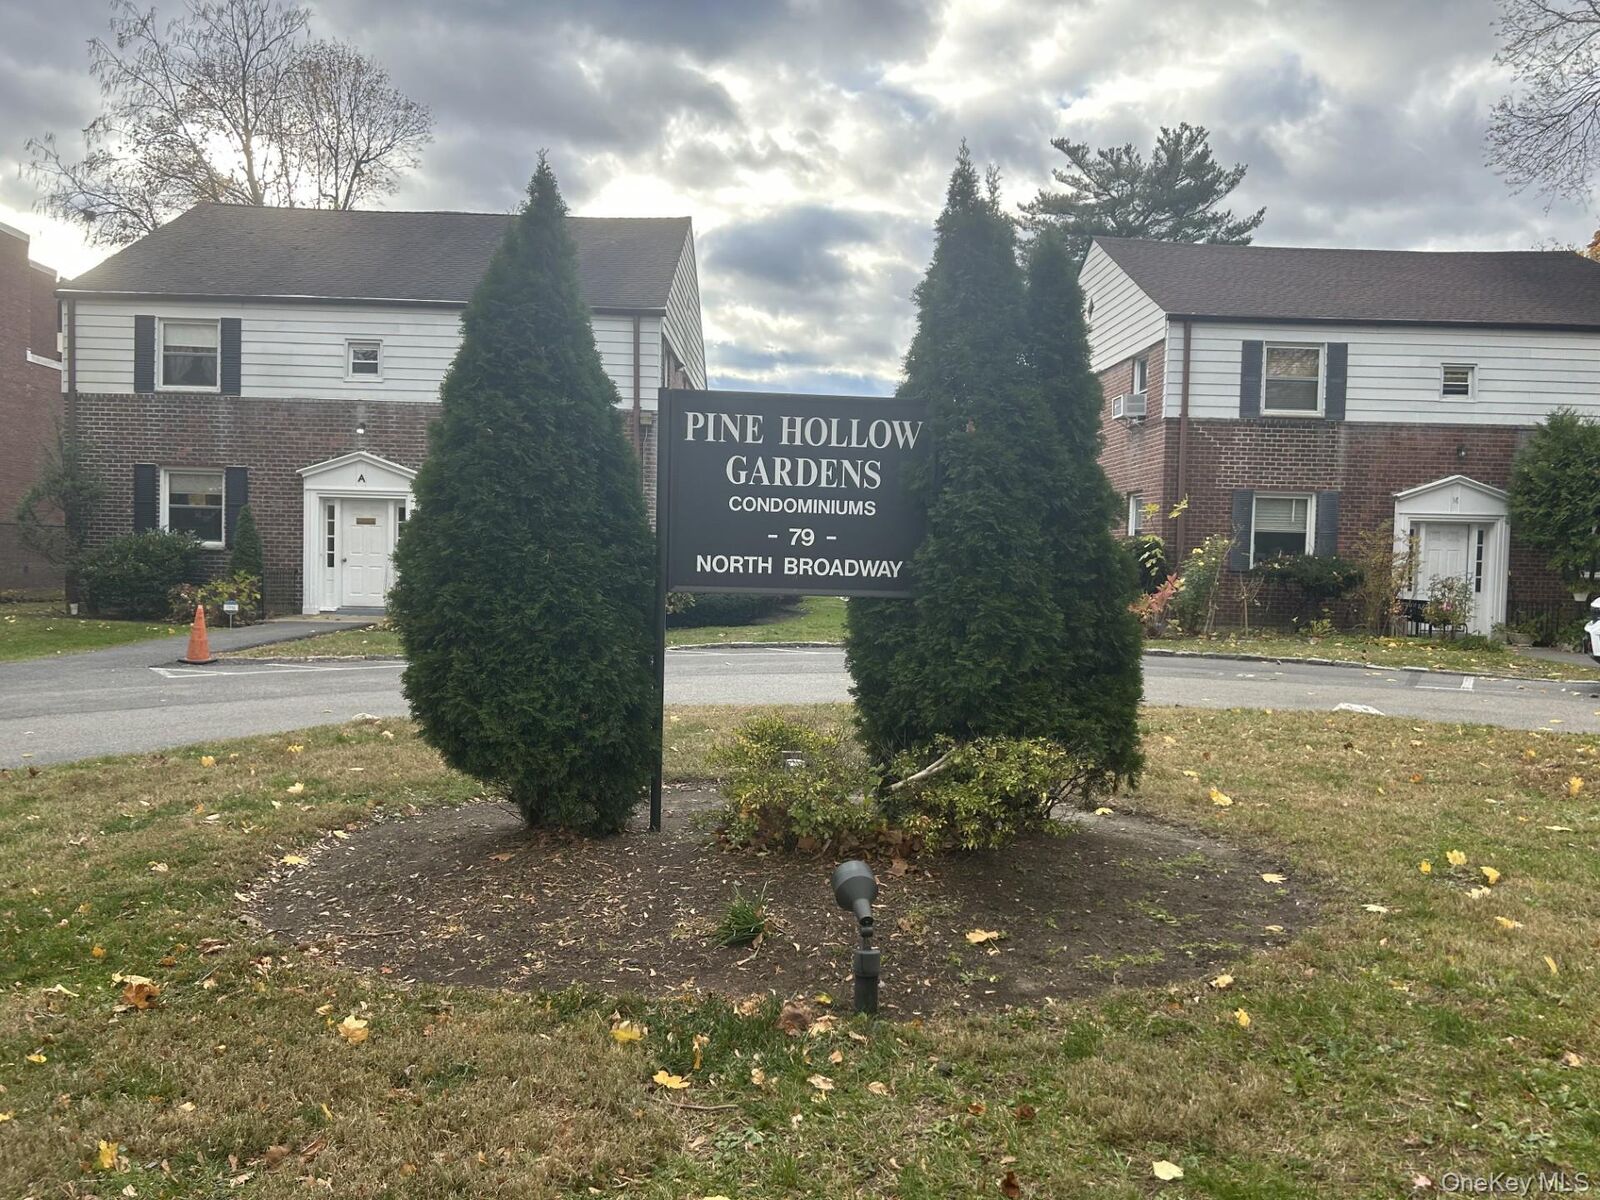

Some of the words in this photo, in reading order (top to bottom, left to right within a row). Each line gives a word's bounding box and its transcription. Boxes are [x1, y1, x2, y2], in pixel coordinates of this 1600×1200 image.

[684, 411, 764, 444] PINE
[779, 415, 924, 450] HOLLOW
[357, 473, 366, 483] A
[726, 455, 882, 489] GARDENS
[728, 496, 876, 516] CONDOMINIUMS
[788, 528, 815, 546] 79
[696, 555, 772, 574] NORTH
[784, 557, 903, 578] BROADWAY
